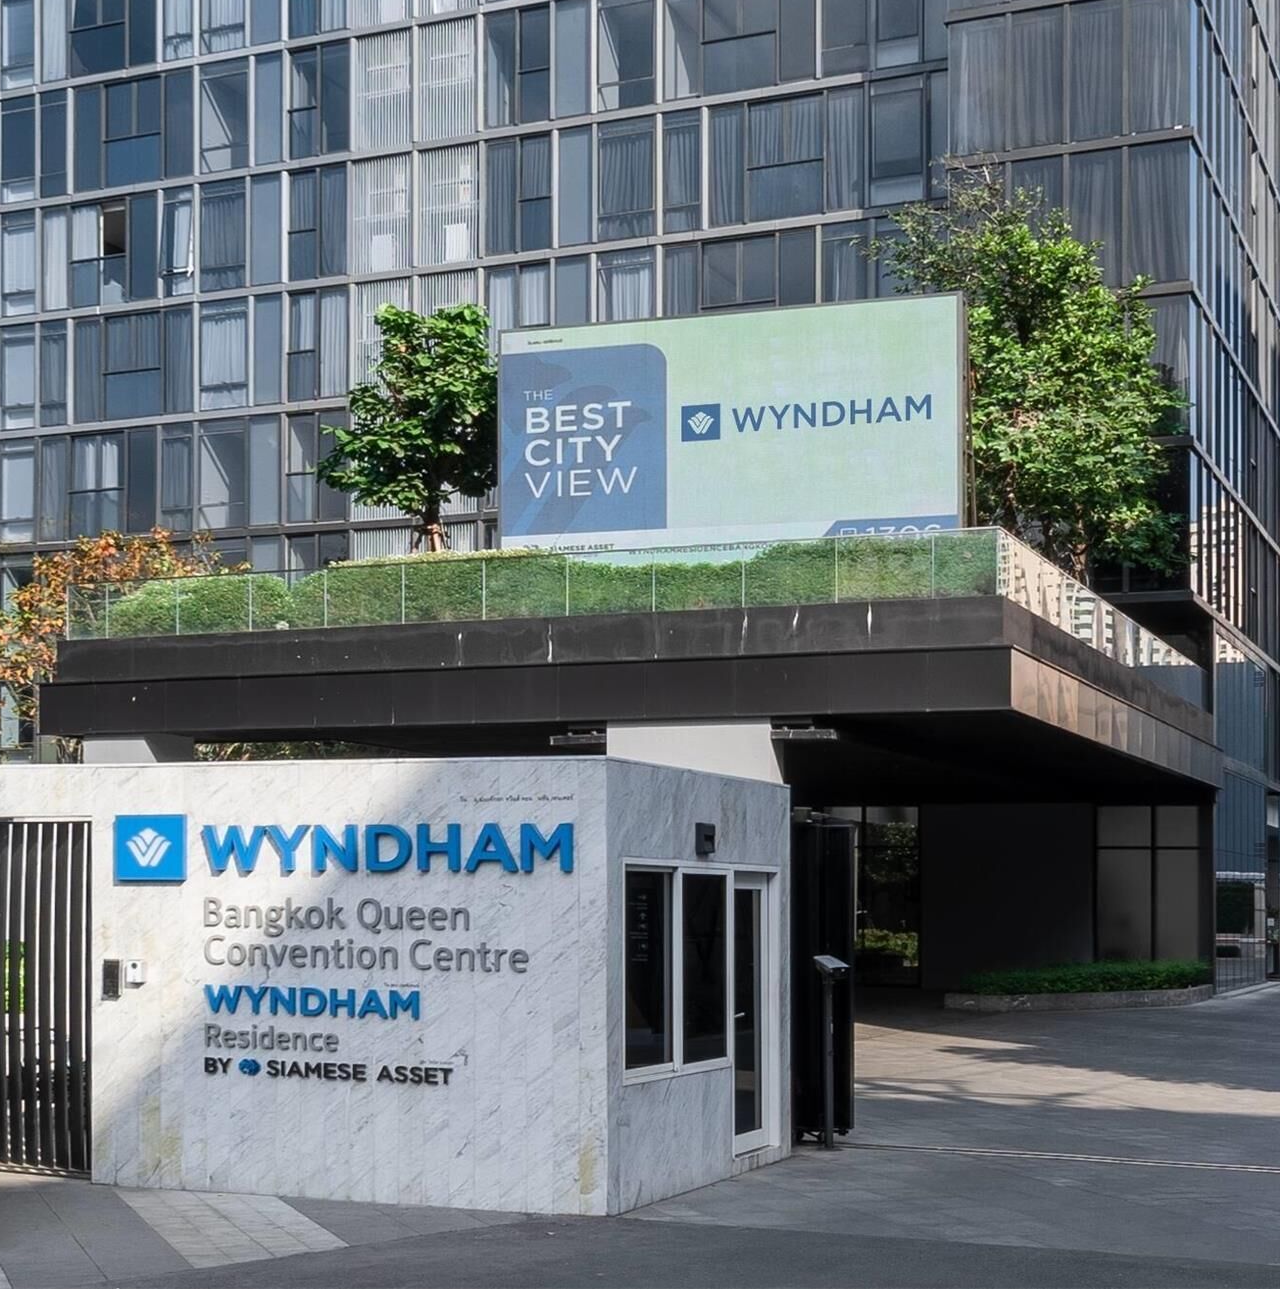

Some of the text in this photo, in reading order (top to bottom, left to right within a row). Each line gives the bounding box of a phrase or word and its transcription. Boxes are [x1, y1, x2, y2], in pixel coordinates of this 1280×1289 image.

[523, 389, 553, 401] THE
[526, 401, 632, 434] BEST
[732, 394, 932, 433] WYNDHAM
[525, 434, 622, 466] CITY
[525, 466, 638, 499] VIEW
[202, 823, 574, 876] WYNDHAM
[203, 897, 471, 936] Bangkok Queen
[203, 936, 529, 973] Convention Centre
[203, 984, 421, 1021] WYNDHAM
[204, 1023, 340, 1052] Residence
[204, 1057, 454, 1086] BY SIAMESE ASSET
